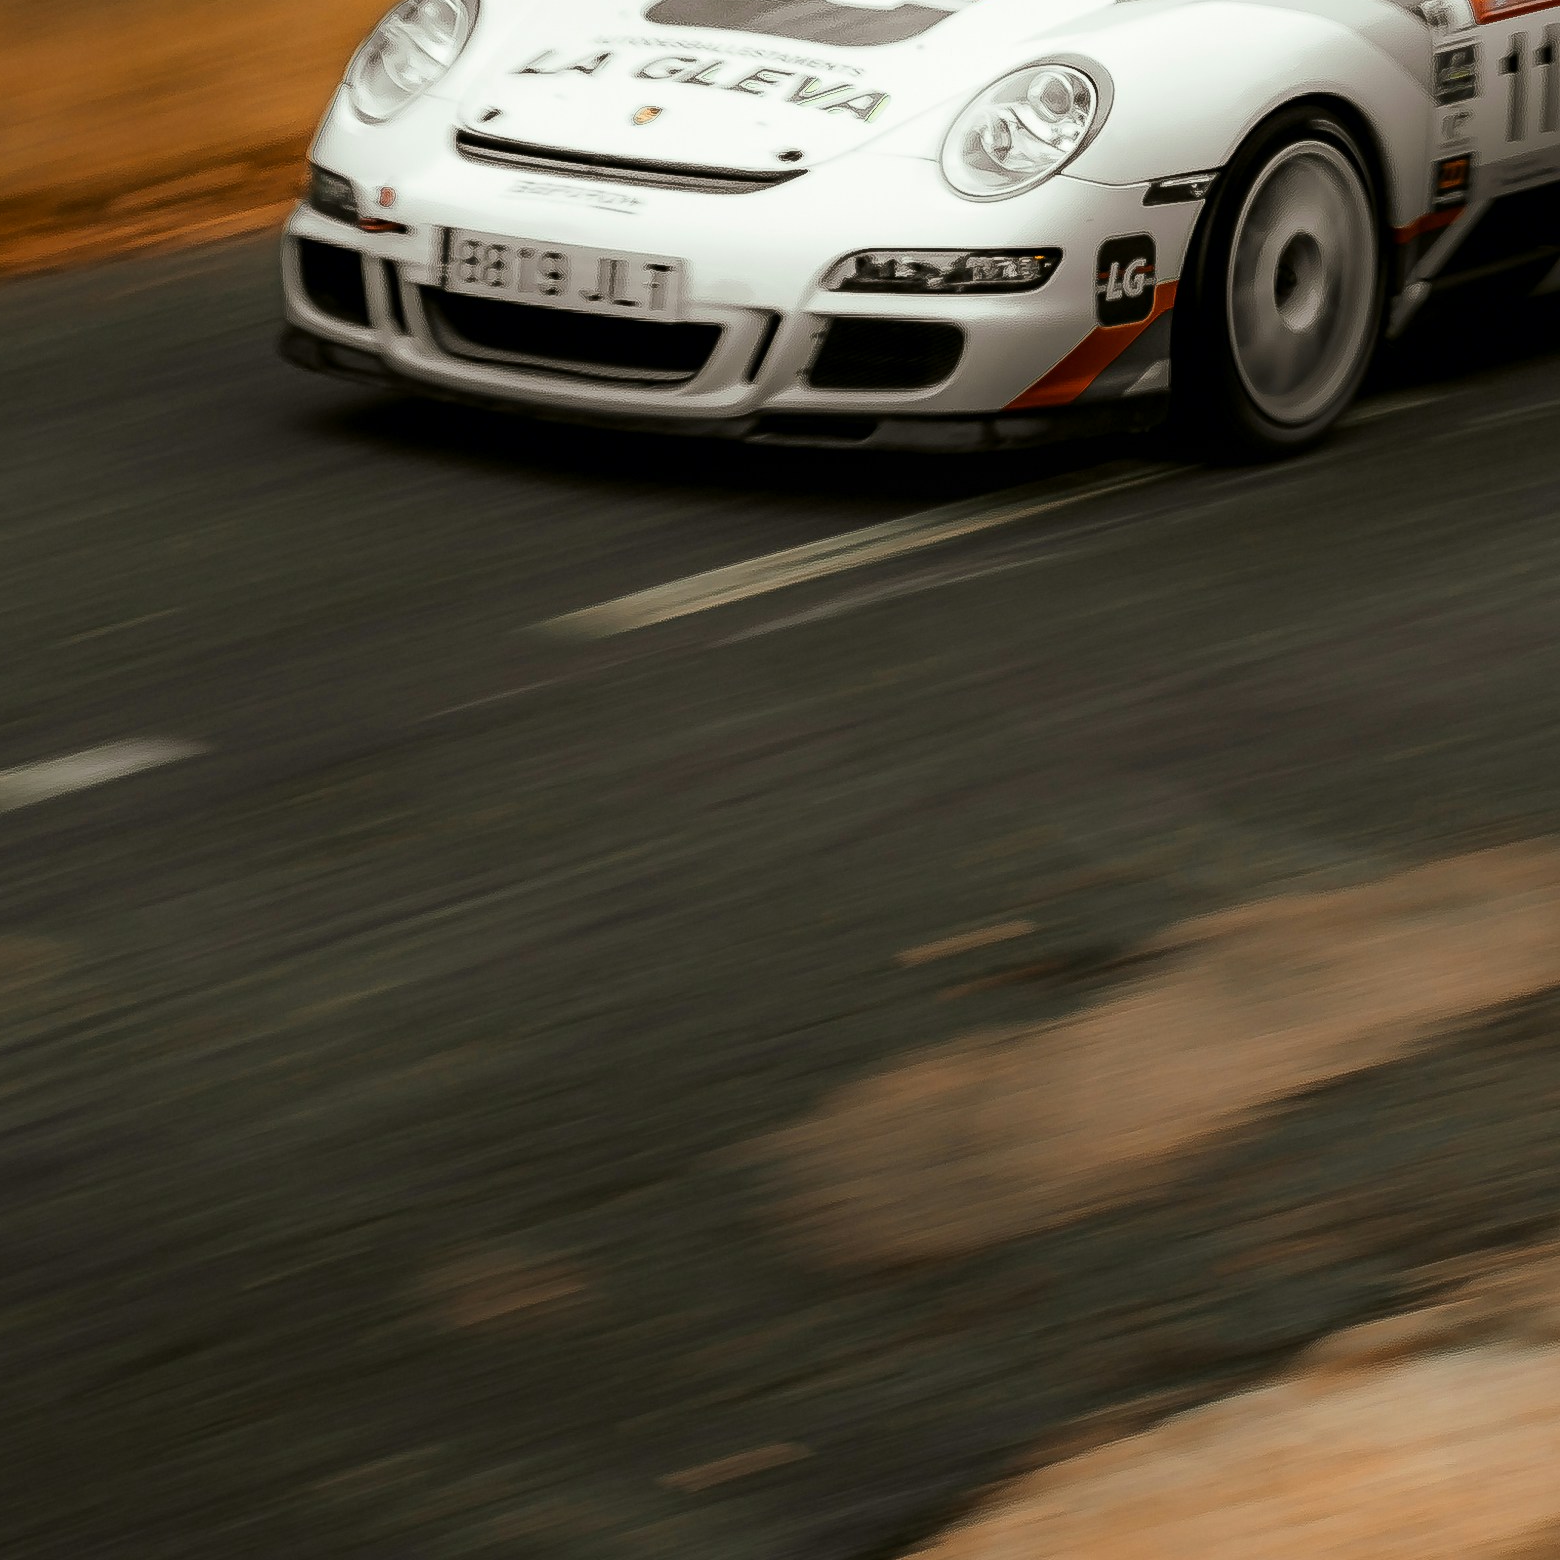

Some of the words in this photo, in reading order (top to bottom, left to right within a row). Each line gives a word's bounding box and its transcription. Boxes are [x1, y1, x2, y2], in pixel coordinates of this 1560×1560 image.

[510, 50, 613, 75] LA
[635, 55, 889, 123] GLEVA
[579, 257, 676, 312] JLT
[1105, 258, 1147, 302] LG
